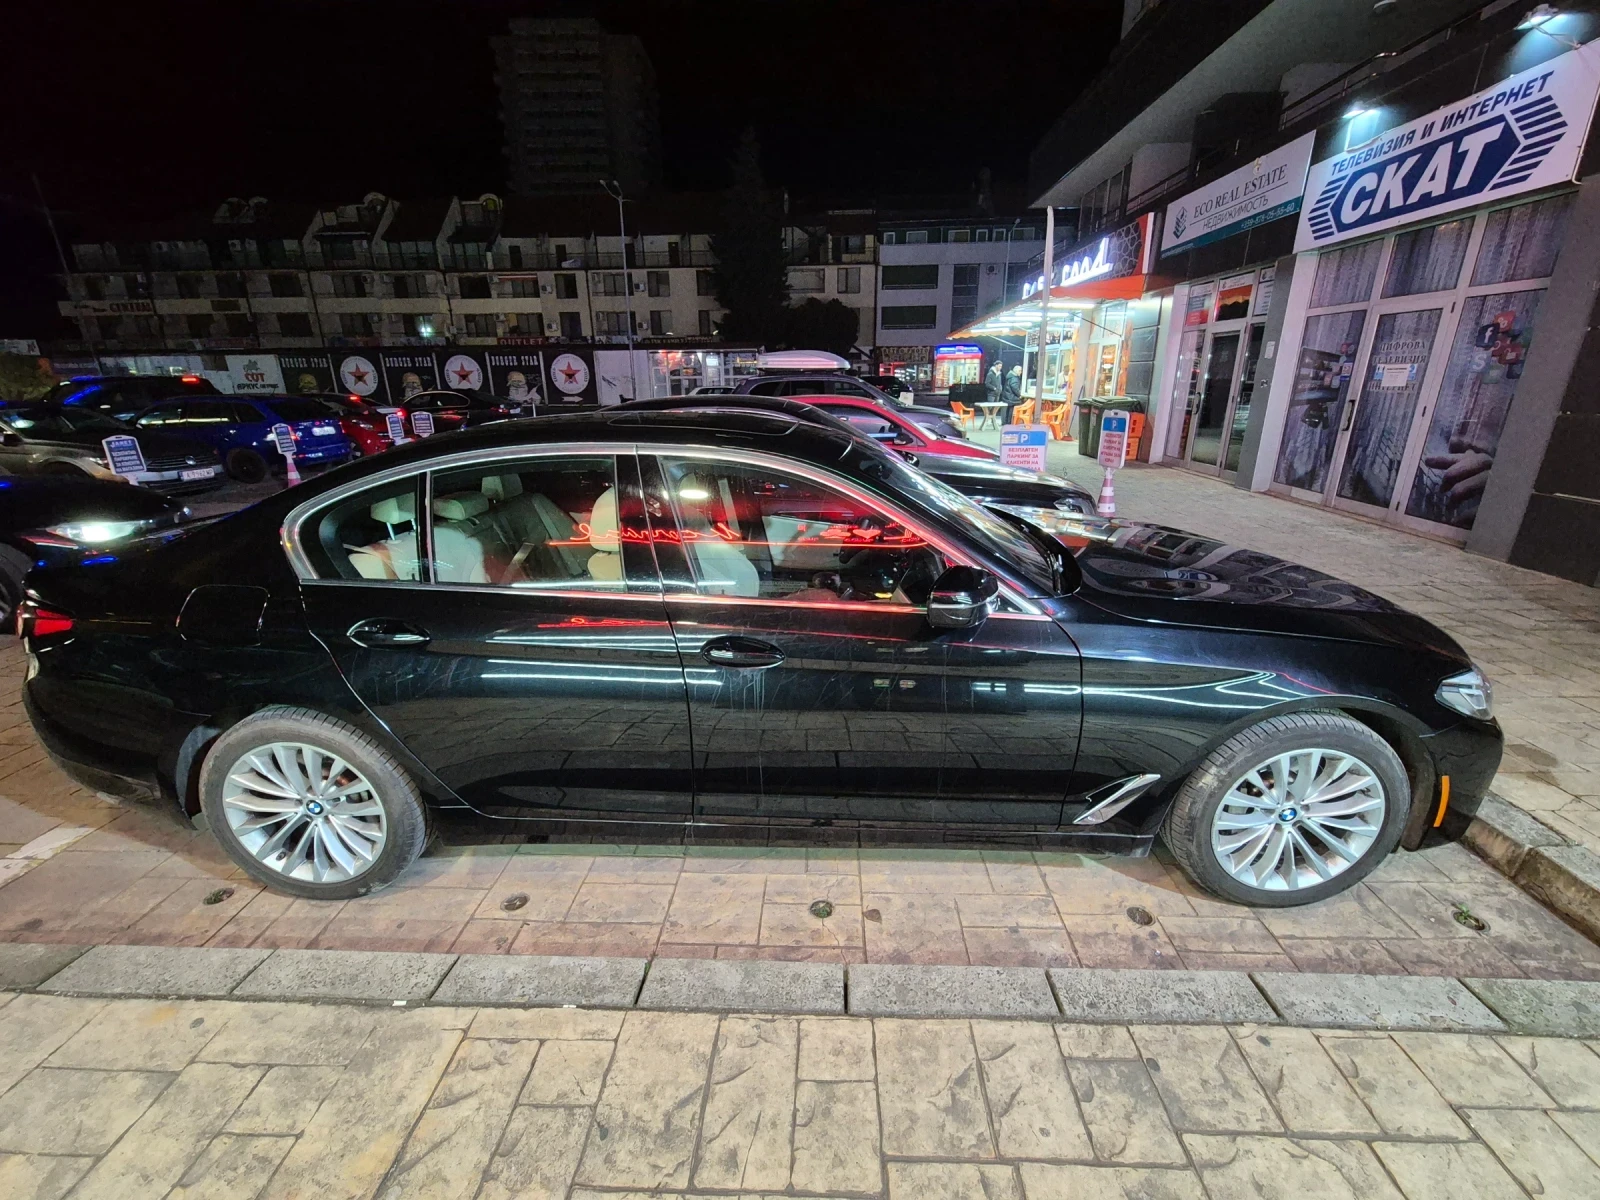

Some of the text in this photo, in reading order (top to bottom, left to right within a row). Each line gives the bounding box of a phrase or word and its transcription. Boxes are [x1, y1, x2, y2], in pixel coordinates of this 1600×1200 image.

[1332, 70, 1555, 177] ТЕЛЕВИЗИЯ И ИНТЕРНЕТ
[1340, 121, 1507, 225] СКАТ
[1193, 163, 1288, 219] ECO REAL ESTATE
[1202, 195, 1269, 231] НЕДВИЖИМОСТЬ
[500, 337, 545, 346] OUTLET
[1380, 341, 1426, 351] ЦИФРОВА
[490, 355, 539, 367] BURGER STAR
[1111, 419, 1117, 429] P
[1020, 433, 1029, 443] P
